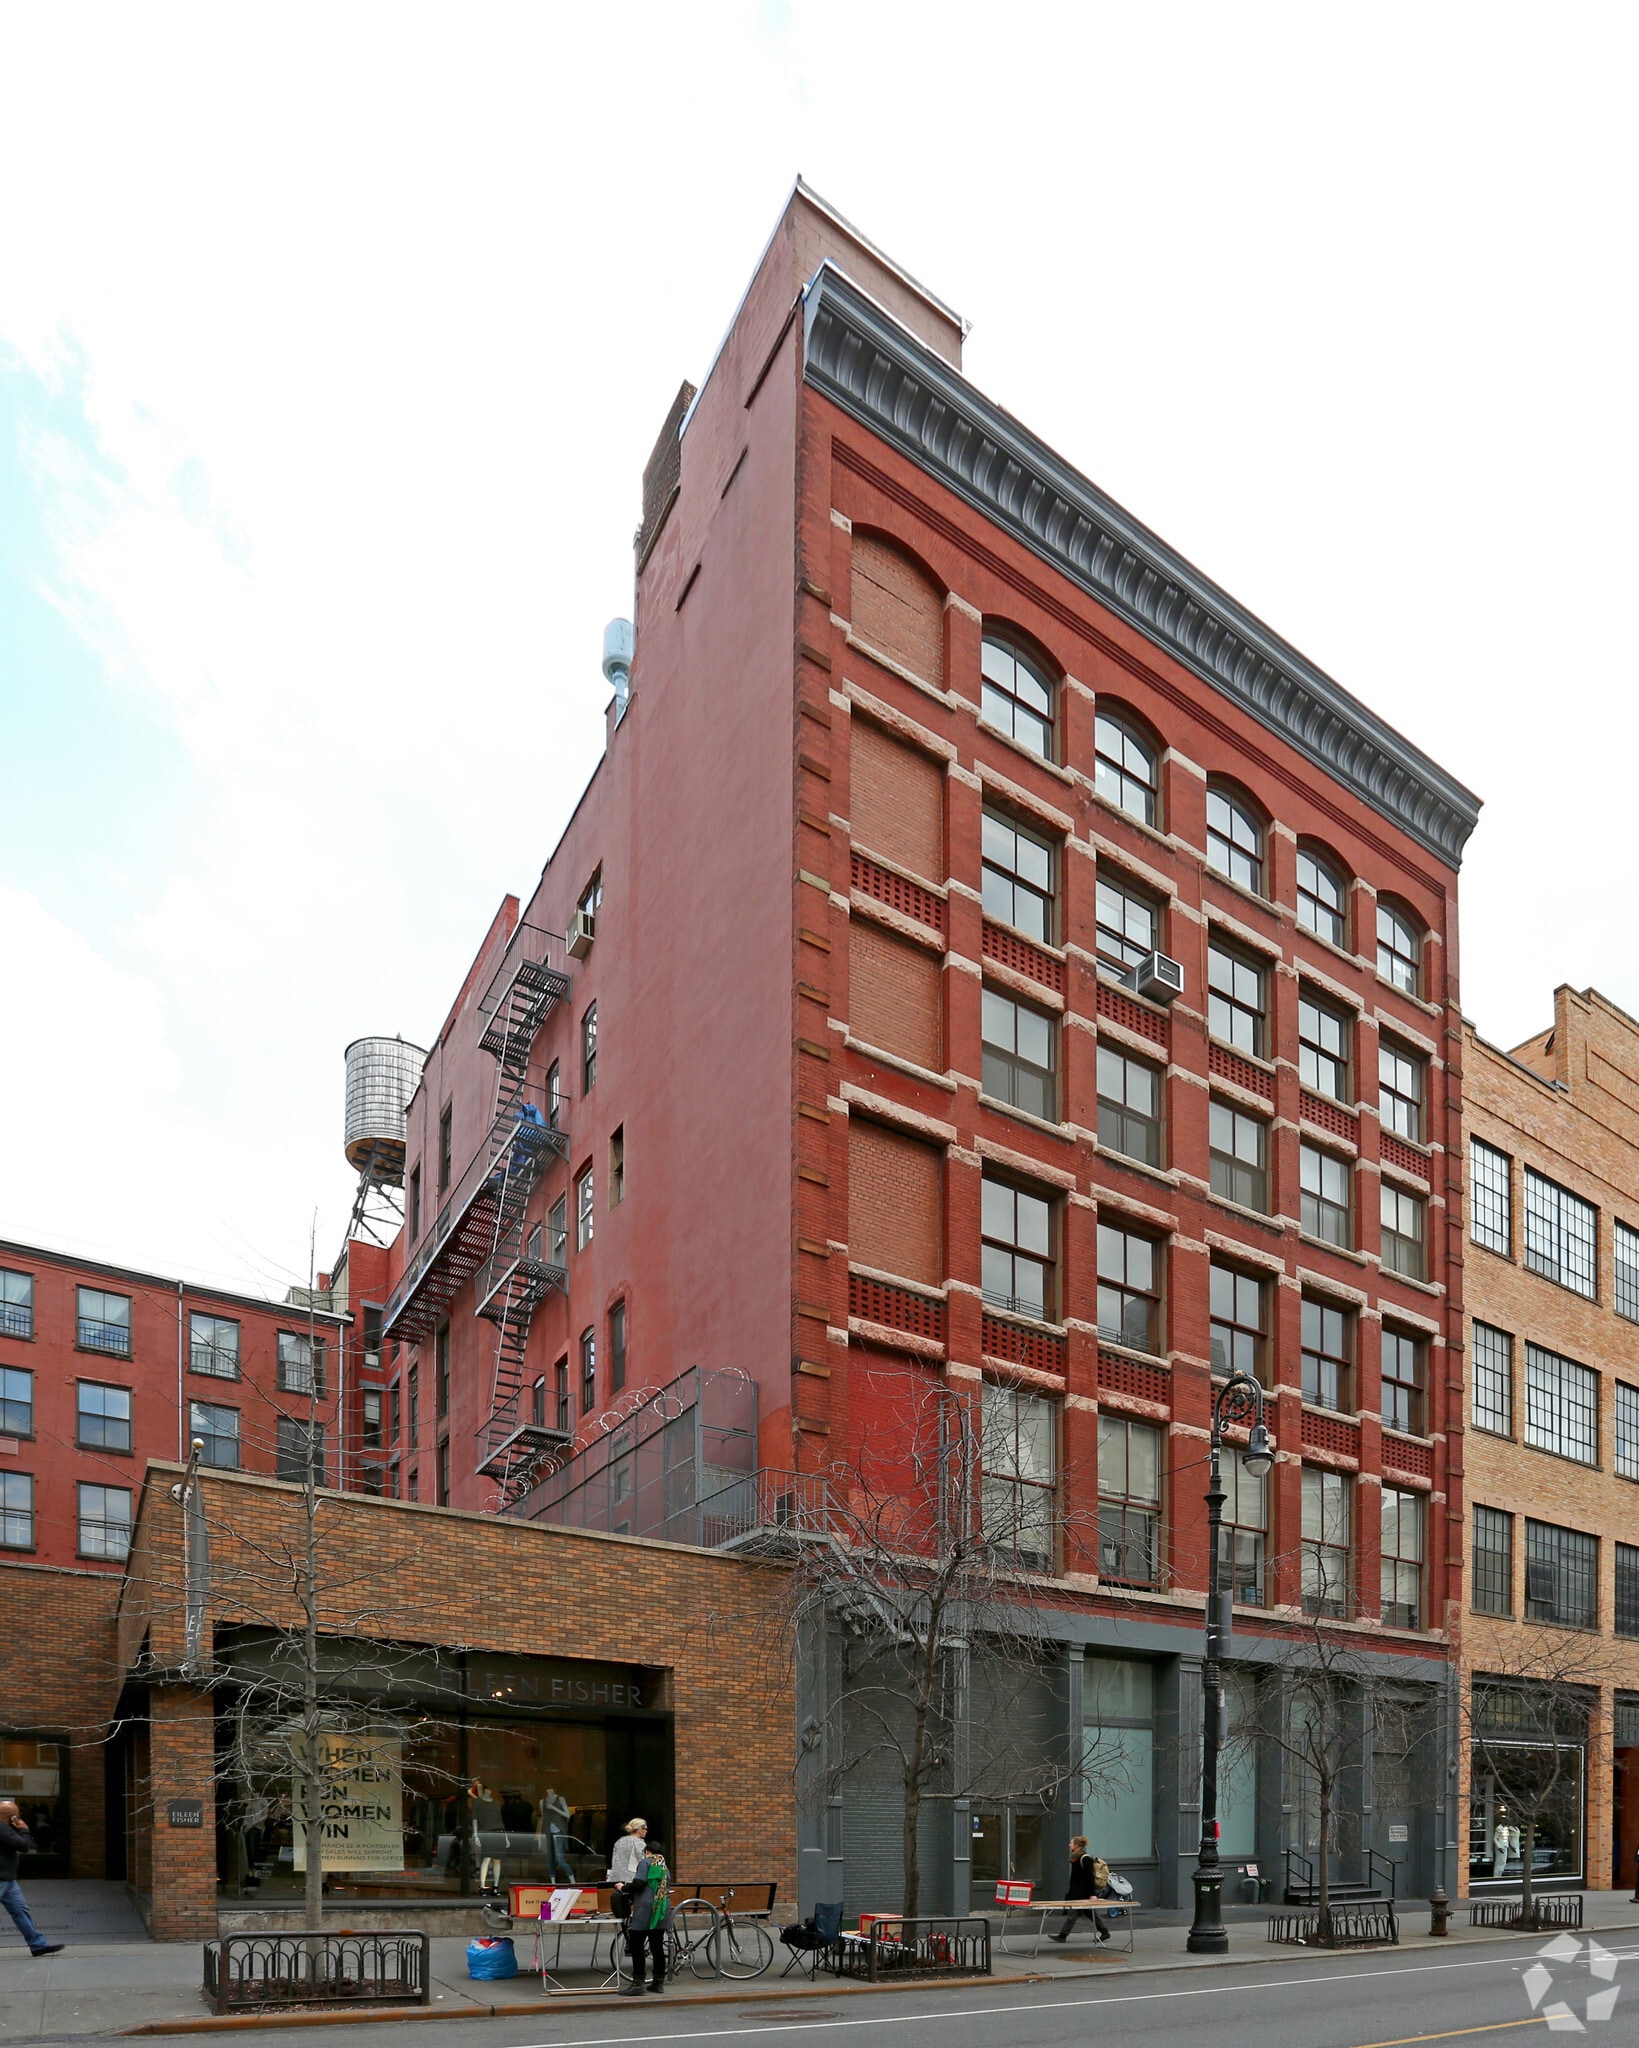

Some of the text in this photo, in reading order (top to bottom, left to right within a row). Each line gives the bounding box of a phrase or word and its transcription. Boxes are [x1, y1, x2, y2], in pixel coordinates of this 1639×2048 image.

[439, 1669, 643, 1706] EILEEN FISHER
[301, 1766, 391, 1783] OMEN
